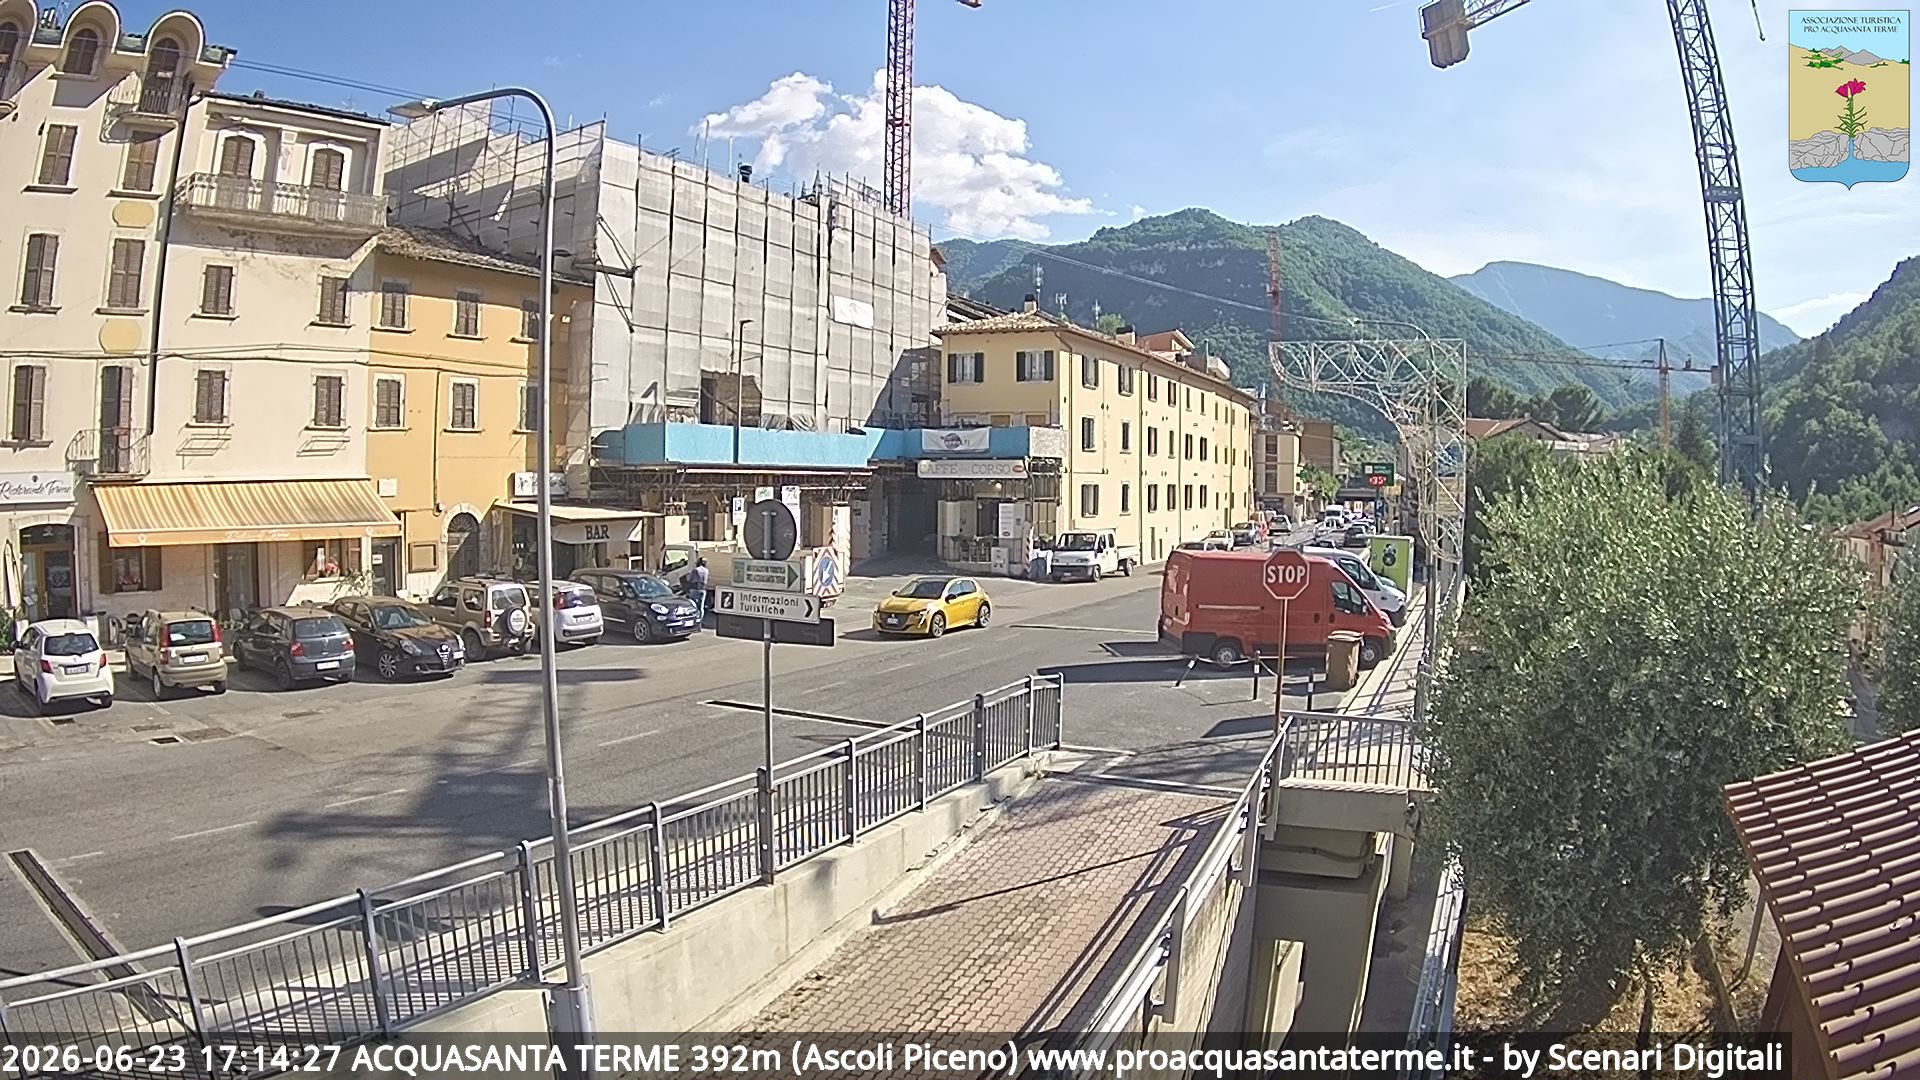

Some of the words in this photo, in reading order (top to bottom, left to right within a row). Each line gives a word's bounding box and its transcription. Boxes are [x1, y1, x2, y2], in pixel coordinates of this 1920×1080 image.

[971, 463, 1011, 475] CORSO
[585, 524, 610, 541] BAR
[1267, 565, 1306, 584] STOP
[740, 592, 799, 607] Informazioni
[740, 602, 785, 615] Turistiche
